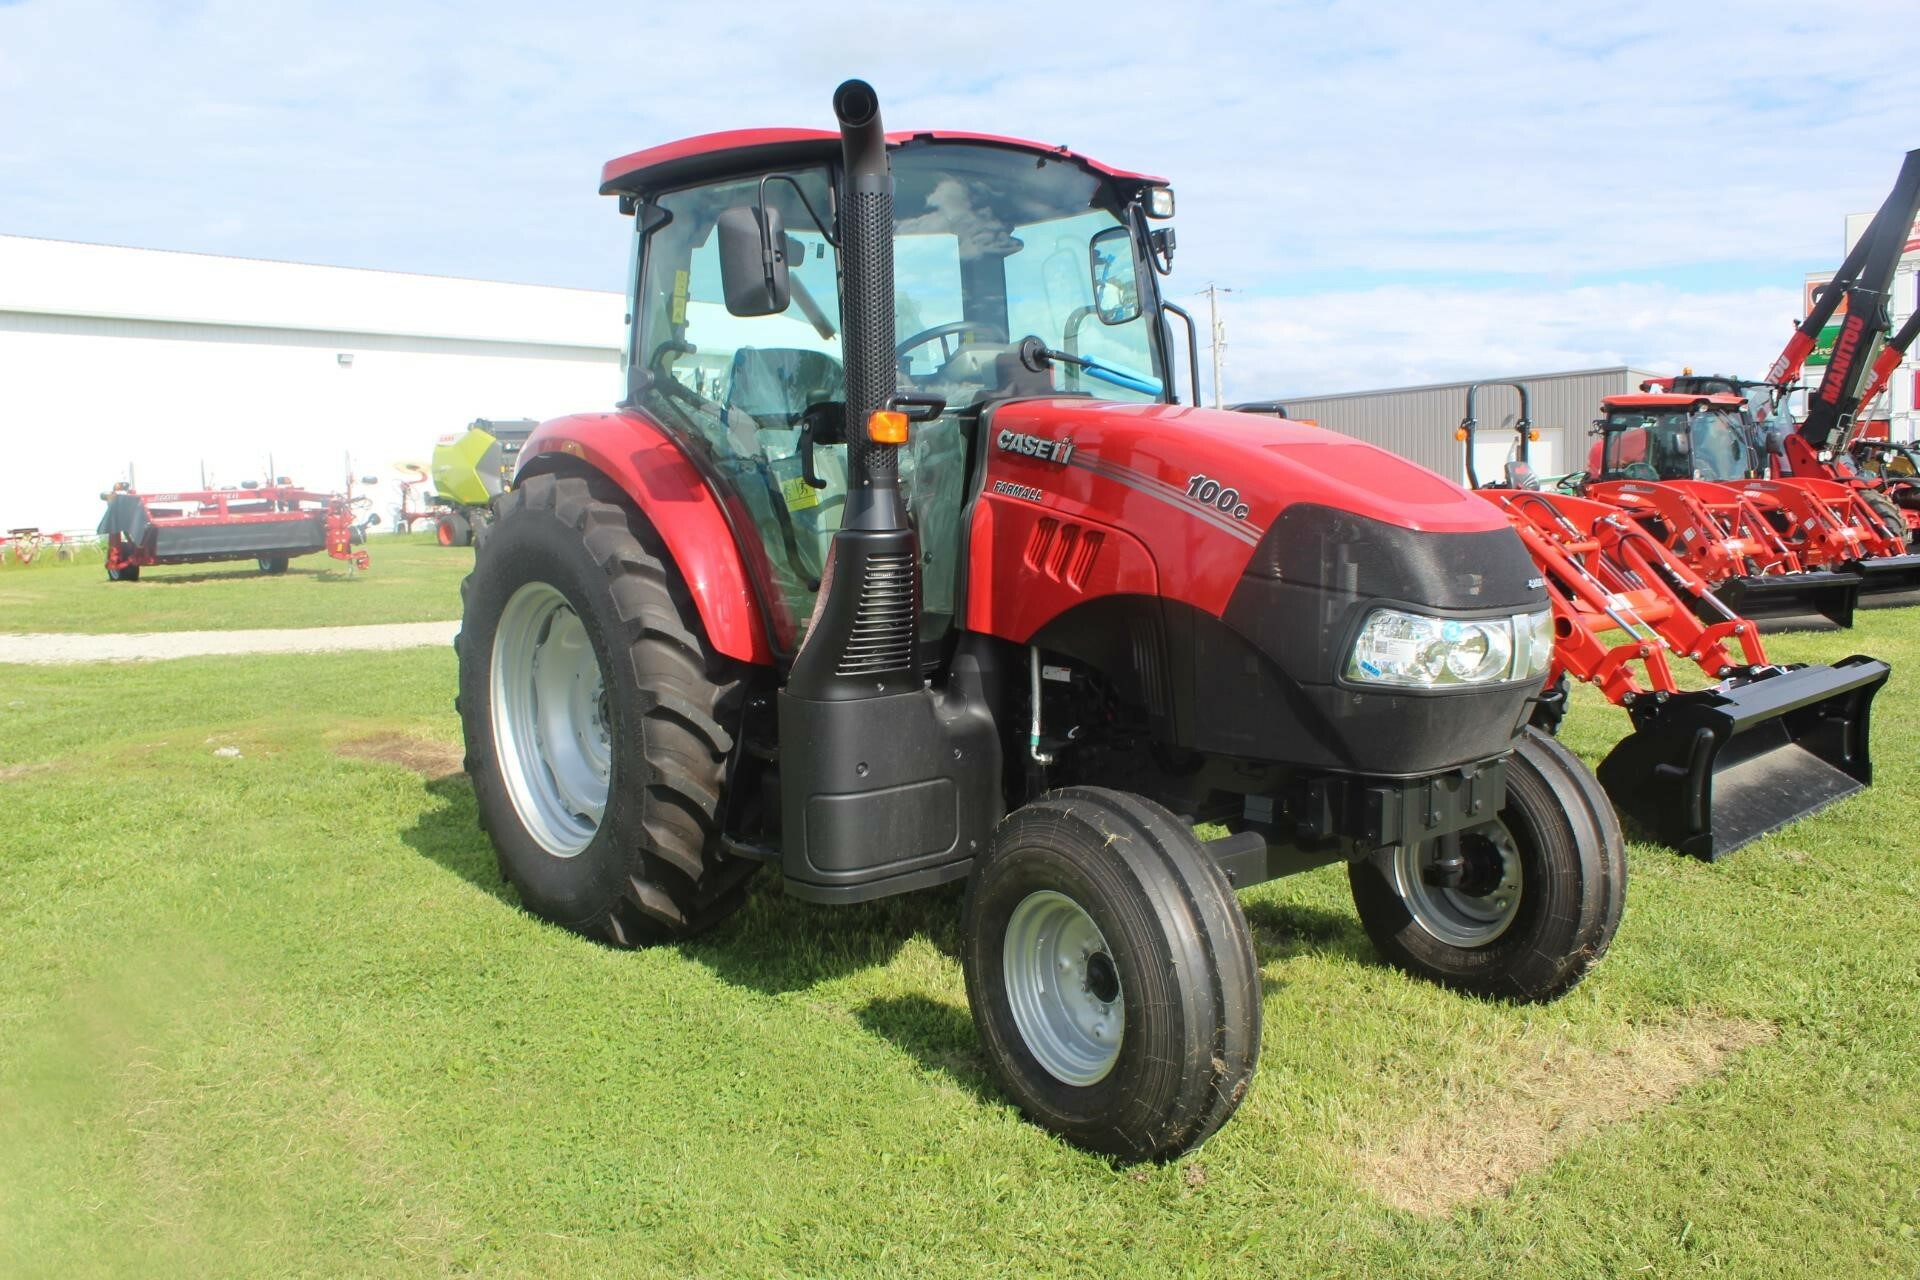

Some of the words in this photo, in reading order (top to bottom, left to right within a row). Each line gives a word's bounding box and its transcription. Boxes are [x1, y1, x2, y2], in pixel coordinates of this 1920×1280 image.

[1821, 315, 1865, 406] MANITOU
[997, 428, 1051, 461] CASE
[992, 480, 1043, 502] FARMALL
